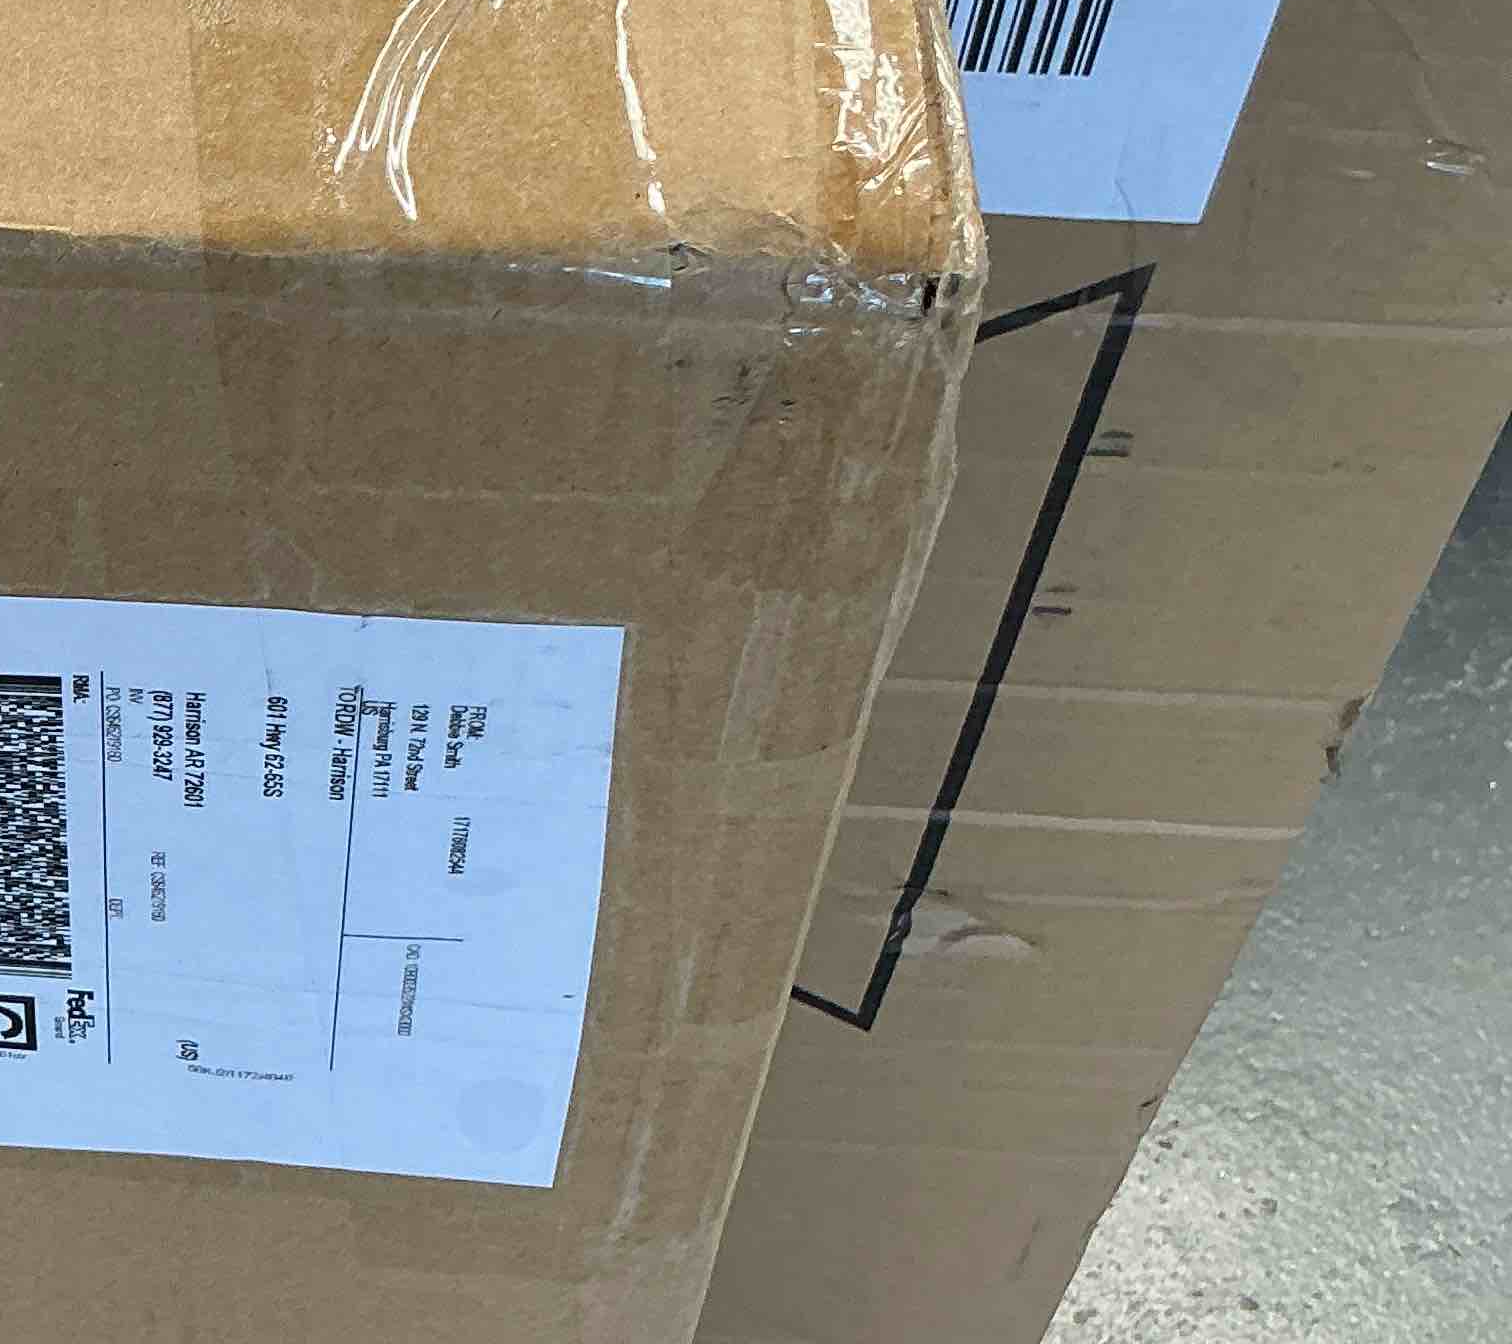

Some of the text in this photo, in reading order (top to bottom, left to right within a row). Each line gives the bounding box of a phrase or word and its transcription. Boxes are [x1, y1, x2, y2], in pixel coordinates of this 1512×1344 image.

[411, 703, 430, 722] 129
[467, 705, 488, 740] FROM:
[147, 690, 173, 782] (877) 929-3247
[184, 692, 207, 807] Harrison AR 72601
[260, 696, 288, 798] 601 Hwy 62-65S
[371, 702, 397, 798] Harrisburg PA 17111
[407, 738, 426, 762] 72nd
[329, 747, 352, 801] Harrison
[404, 763, 423, 791] Street
[176, 1040, 199, 1061] (US)
